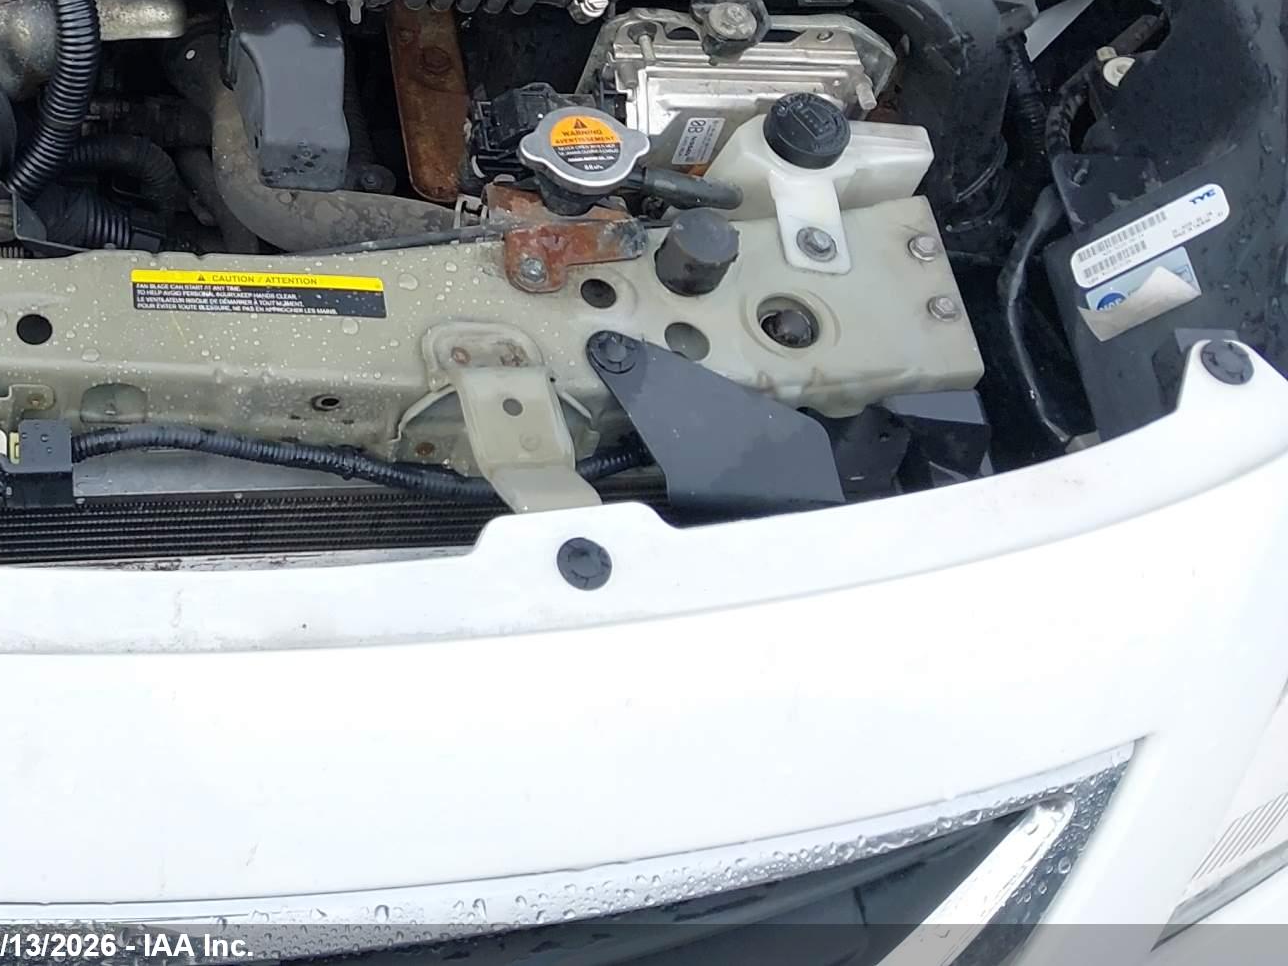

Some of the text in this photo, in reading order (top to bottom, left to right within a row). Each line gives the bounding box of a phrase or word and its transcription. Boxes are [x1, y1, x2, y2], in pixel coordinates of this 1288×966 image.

[561, 129, 602, 137] WARNING
[555, 136, 614, 144] AVERTISSEMENT
[1189, 188, 1216, 205] TYC
[212, 274, 254, 283] CAUTION
[265, 276, 318, 285] ATTENTION
